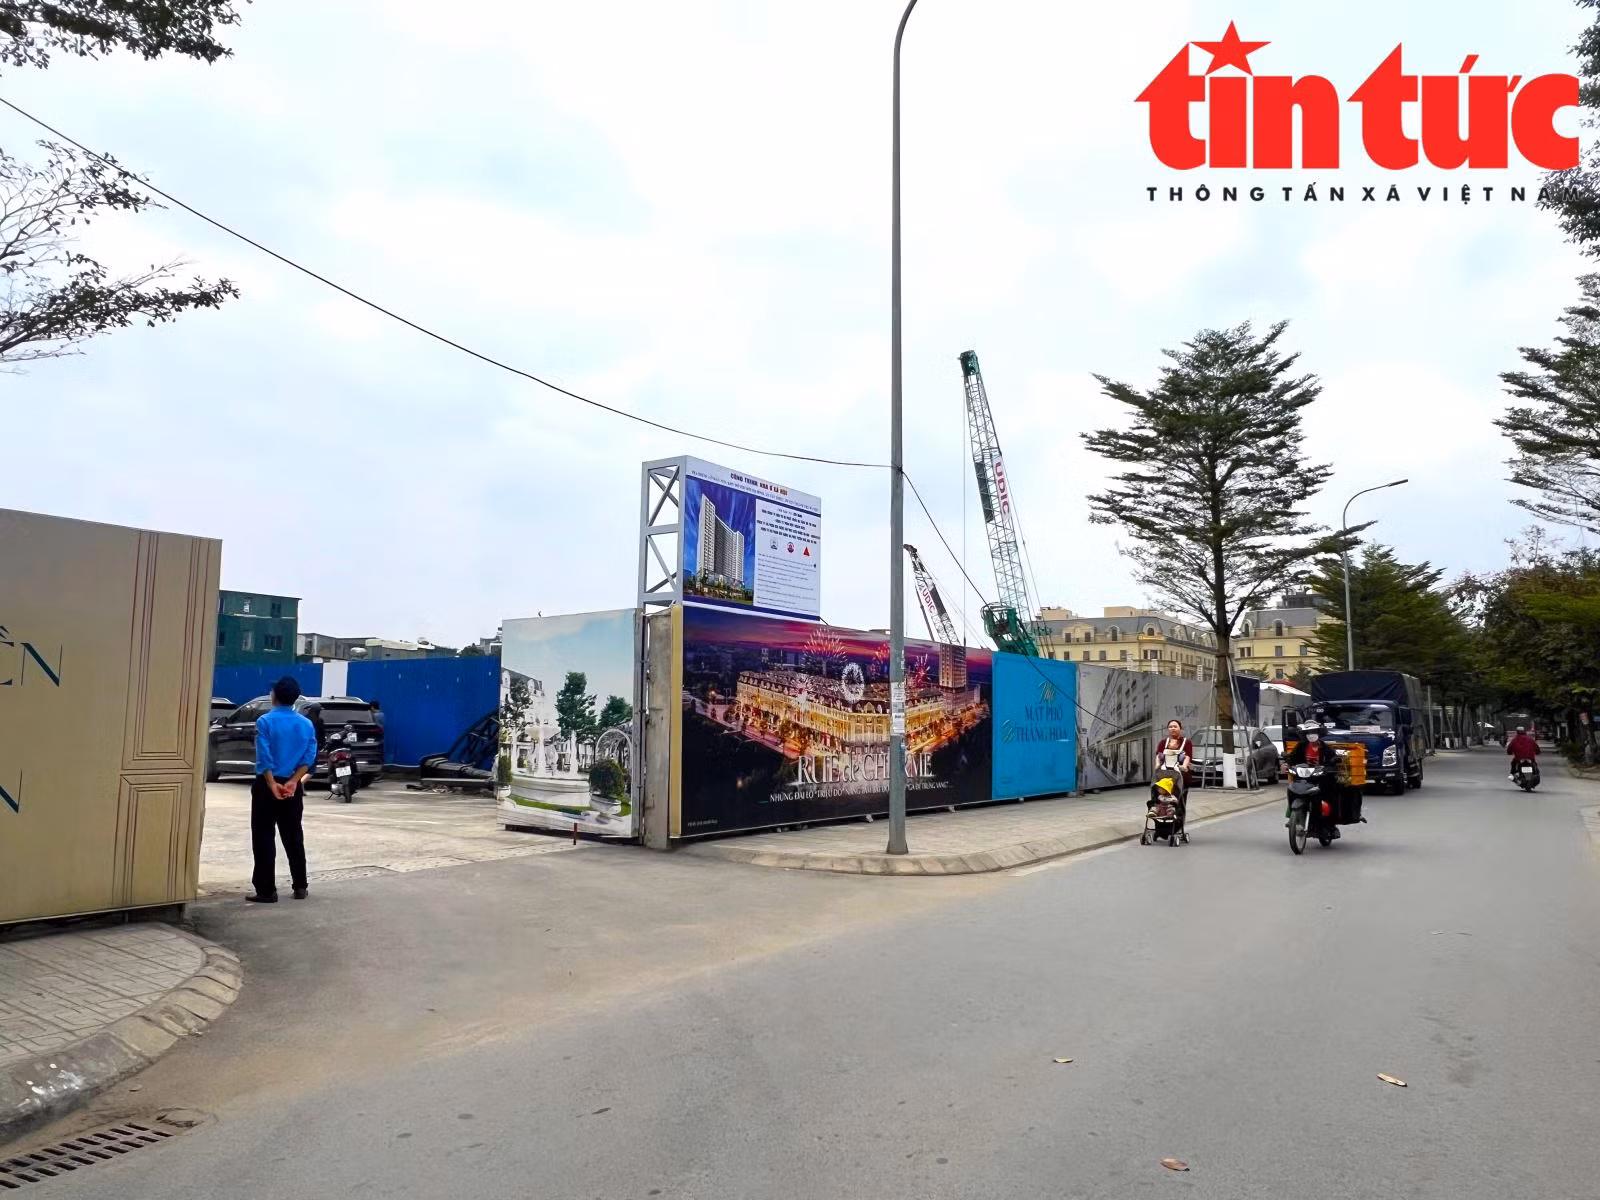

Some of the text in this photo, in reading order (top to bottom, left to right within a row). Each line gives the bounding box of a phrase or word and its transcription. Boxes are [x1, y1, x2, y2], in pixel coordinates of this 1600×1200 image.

[995, 461, 1010, 515] UDIC
[922, 588, 936, 614] UDIC
[798, 754, 841, 784] RUE
[843, 752, 860, 782] de
